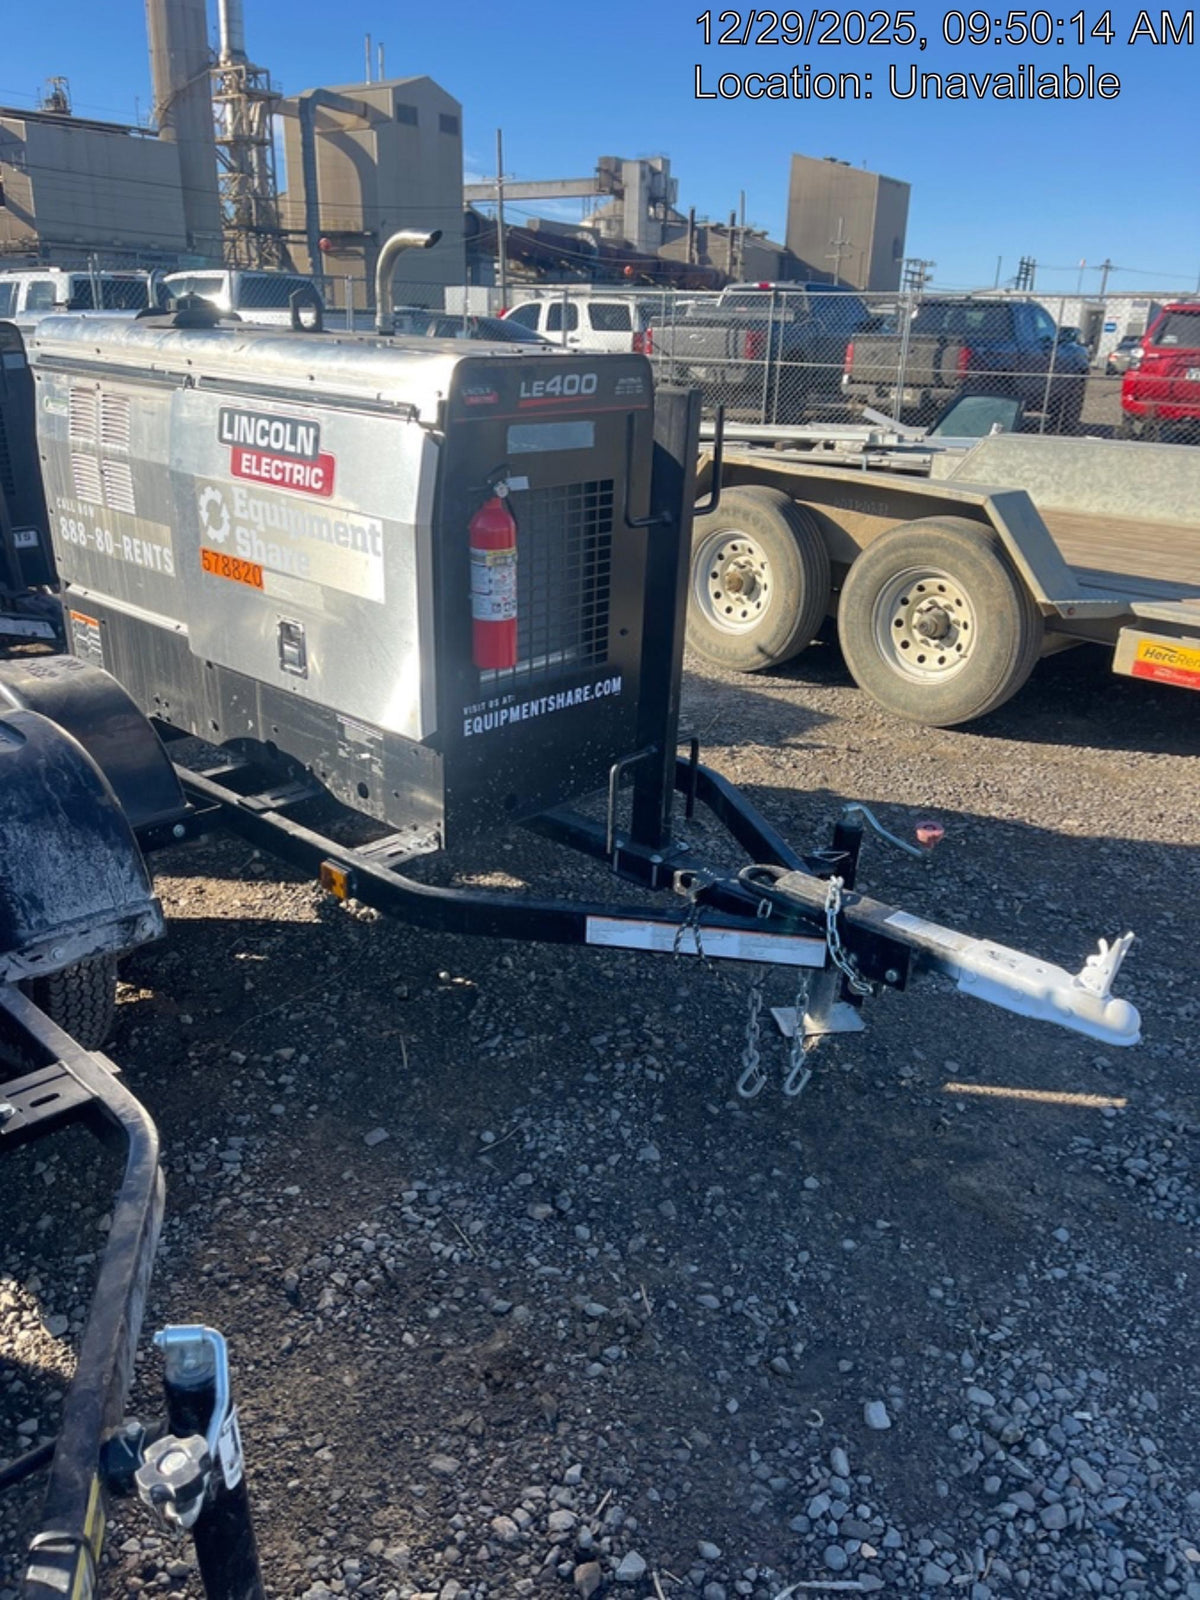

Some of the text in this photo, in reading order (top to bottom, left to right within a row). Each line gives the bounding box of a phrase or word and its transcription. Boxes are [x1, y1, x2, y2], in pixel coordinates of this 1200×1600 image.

[519, 373, 597, 398] LE400
[222, 412, 315, 456] LINCOLN
[241, 453, 323, 489] ELECTRIC
[231, 486, 382, 557] Equipment
[60, 516, 175, 575] 888-80-RENTS
[234, 525, 310, 573] Share
[201, 550, 263, 588] 578820
[463, 675, 622, 737] EQUIPMENTSHARE.COM
[463, 702, 486, 716] VISIT
